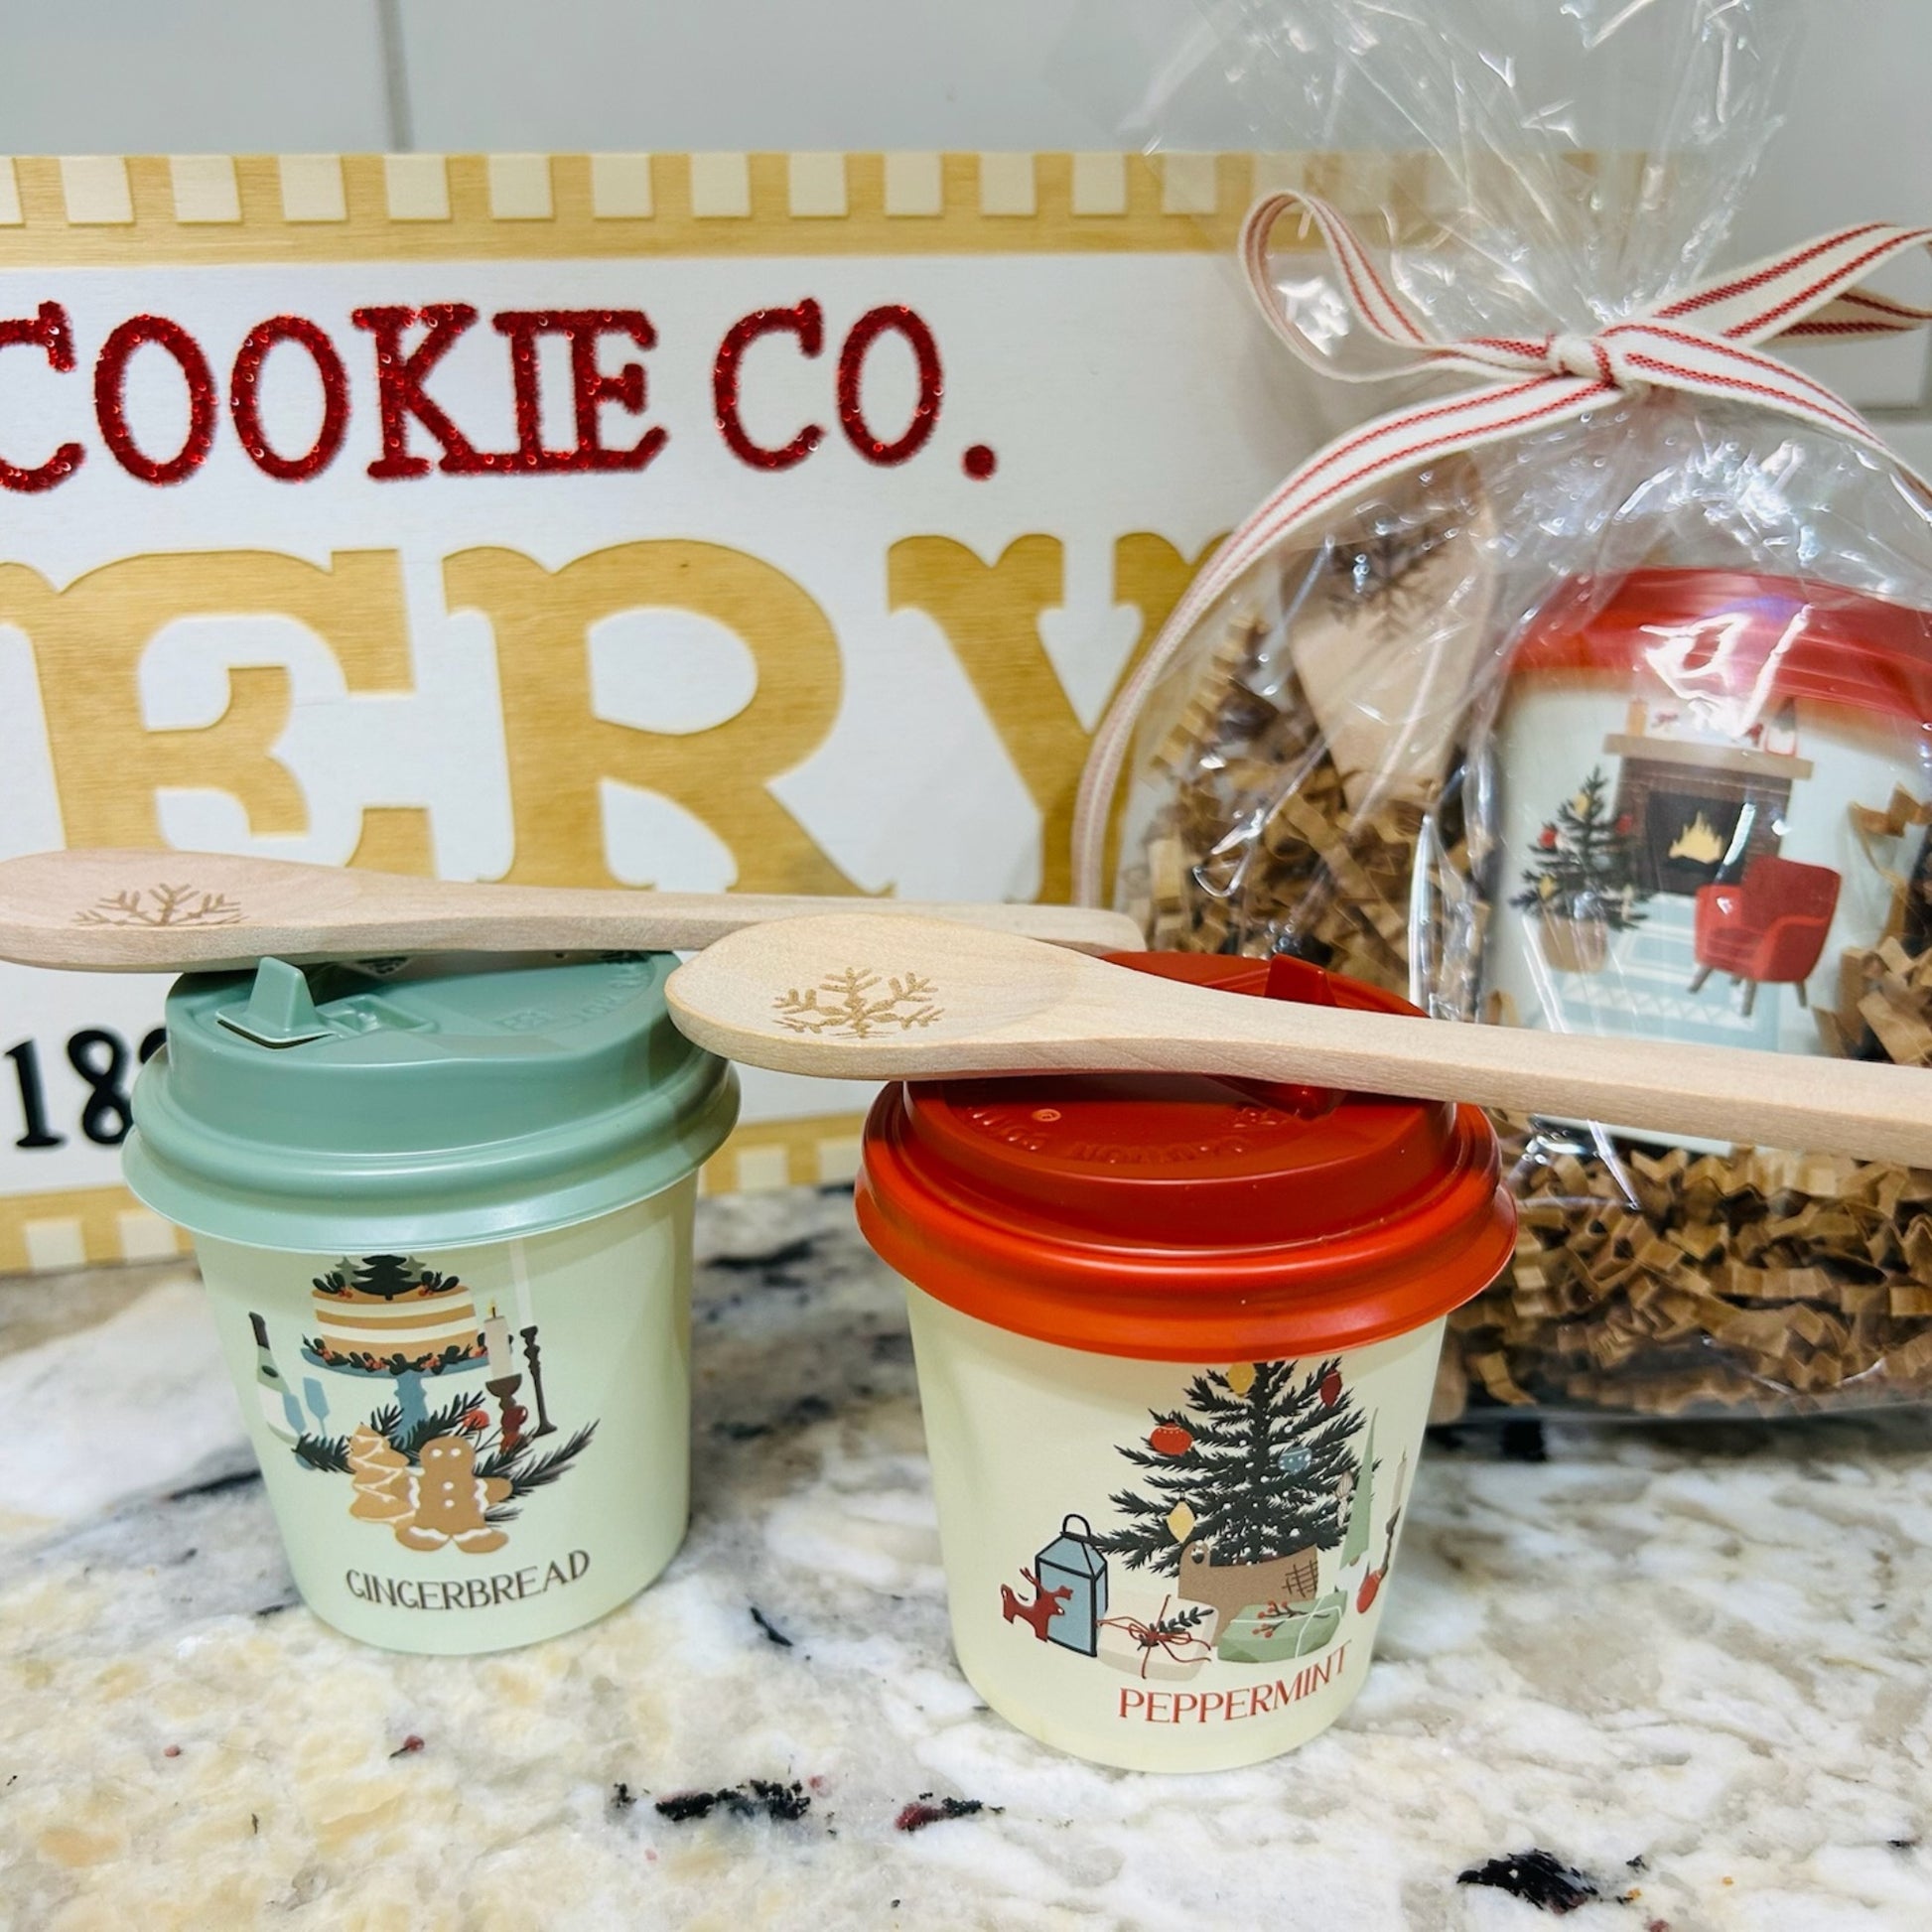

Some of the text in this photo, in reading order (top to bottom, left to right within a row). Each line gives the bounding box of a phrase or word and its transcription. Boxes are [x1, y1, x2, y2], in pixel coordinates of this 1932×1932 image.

[0, 297, 1000, 494] COOKIE CO.
[4, 1028, 168, 1149] 18
[345, 1549, 591, 1611] GINGERBREAD
[1119, 1638, 1352, 1724] PEPPERMINT
